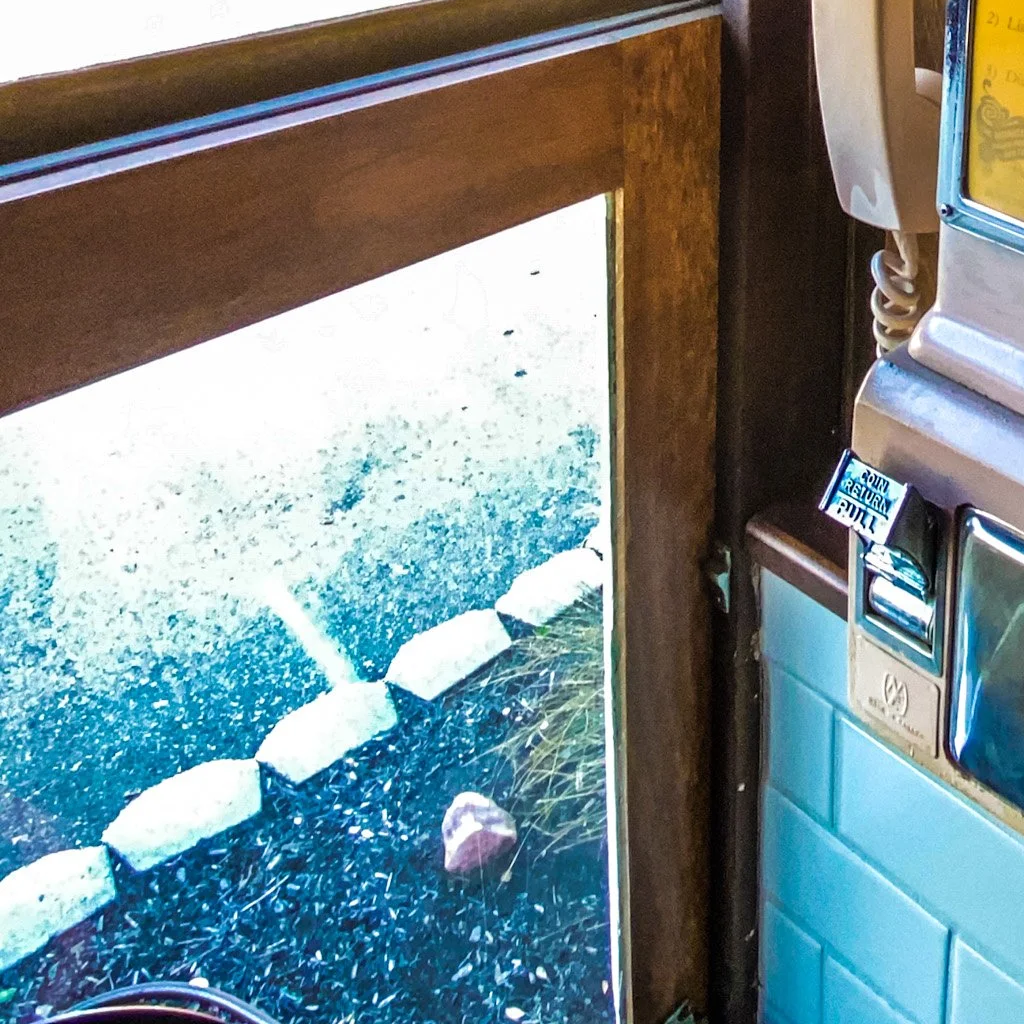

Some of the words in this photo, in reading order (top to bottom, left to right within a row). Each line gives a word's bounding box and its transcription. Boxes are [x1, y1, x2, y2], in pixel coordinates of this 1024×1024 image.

[985, 10, 1000, 27] 2)
[844, 478, 892, 515] RETURN
[861, 469, 890, 494] COIN
[836, 498, 877, 534] PULL
